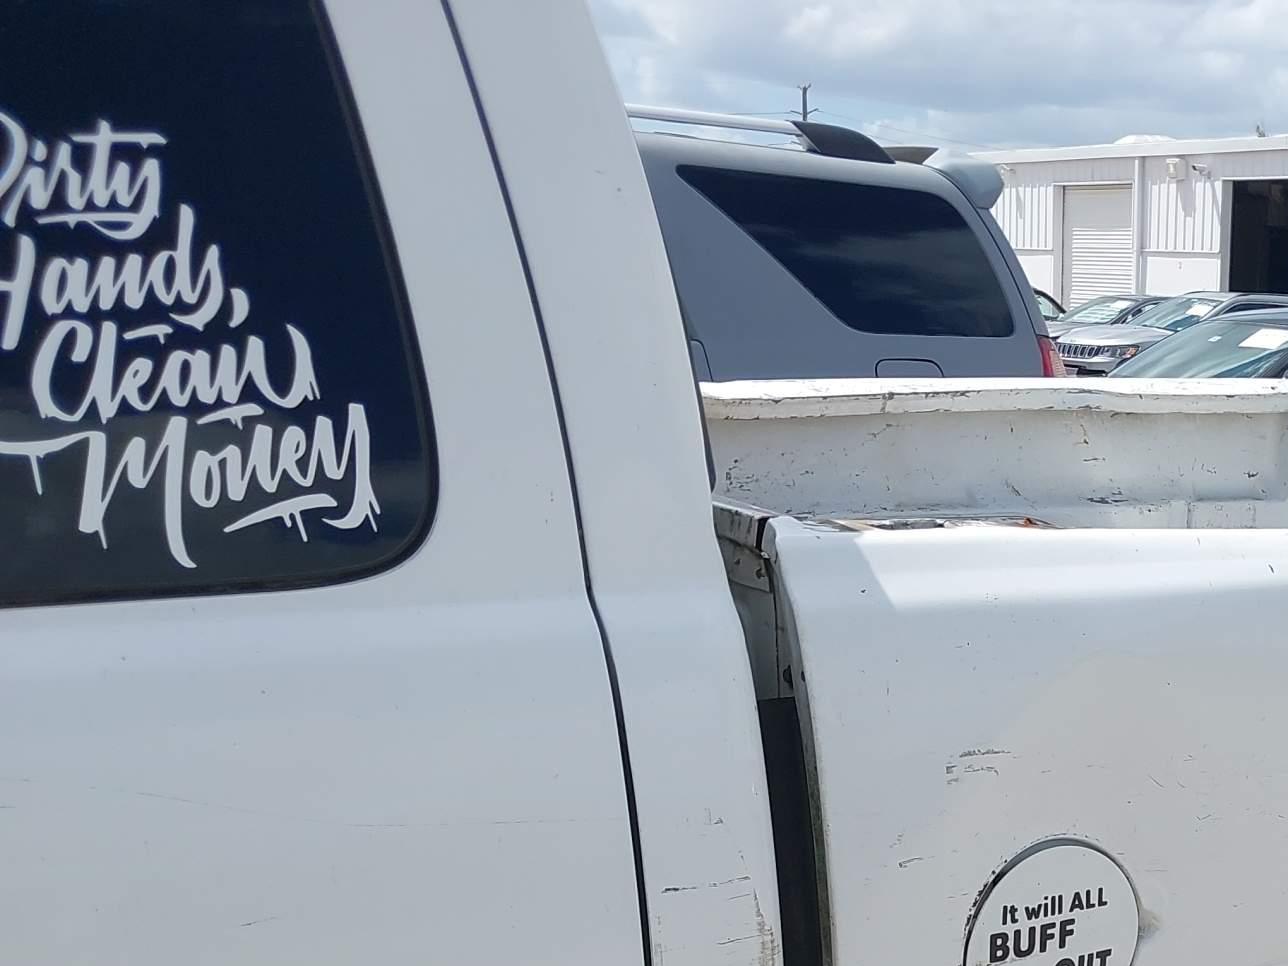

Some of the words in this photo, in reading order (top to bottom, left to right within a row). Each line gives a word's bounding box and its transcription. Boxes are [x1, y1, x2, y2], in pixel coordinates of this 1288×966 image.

[32, 320, 320, 424] Clean
[0, 403, 380, 568] Money
[989, 918, 1076, 963] BUFF
[1001, 904, 1019, 926] It
[1024, 895, 1063, 920] will
[1069, 887, 1108, 913] ALL
